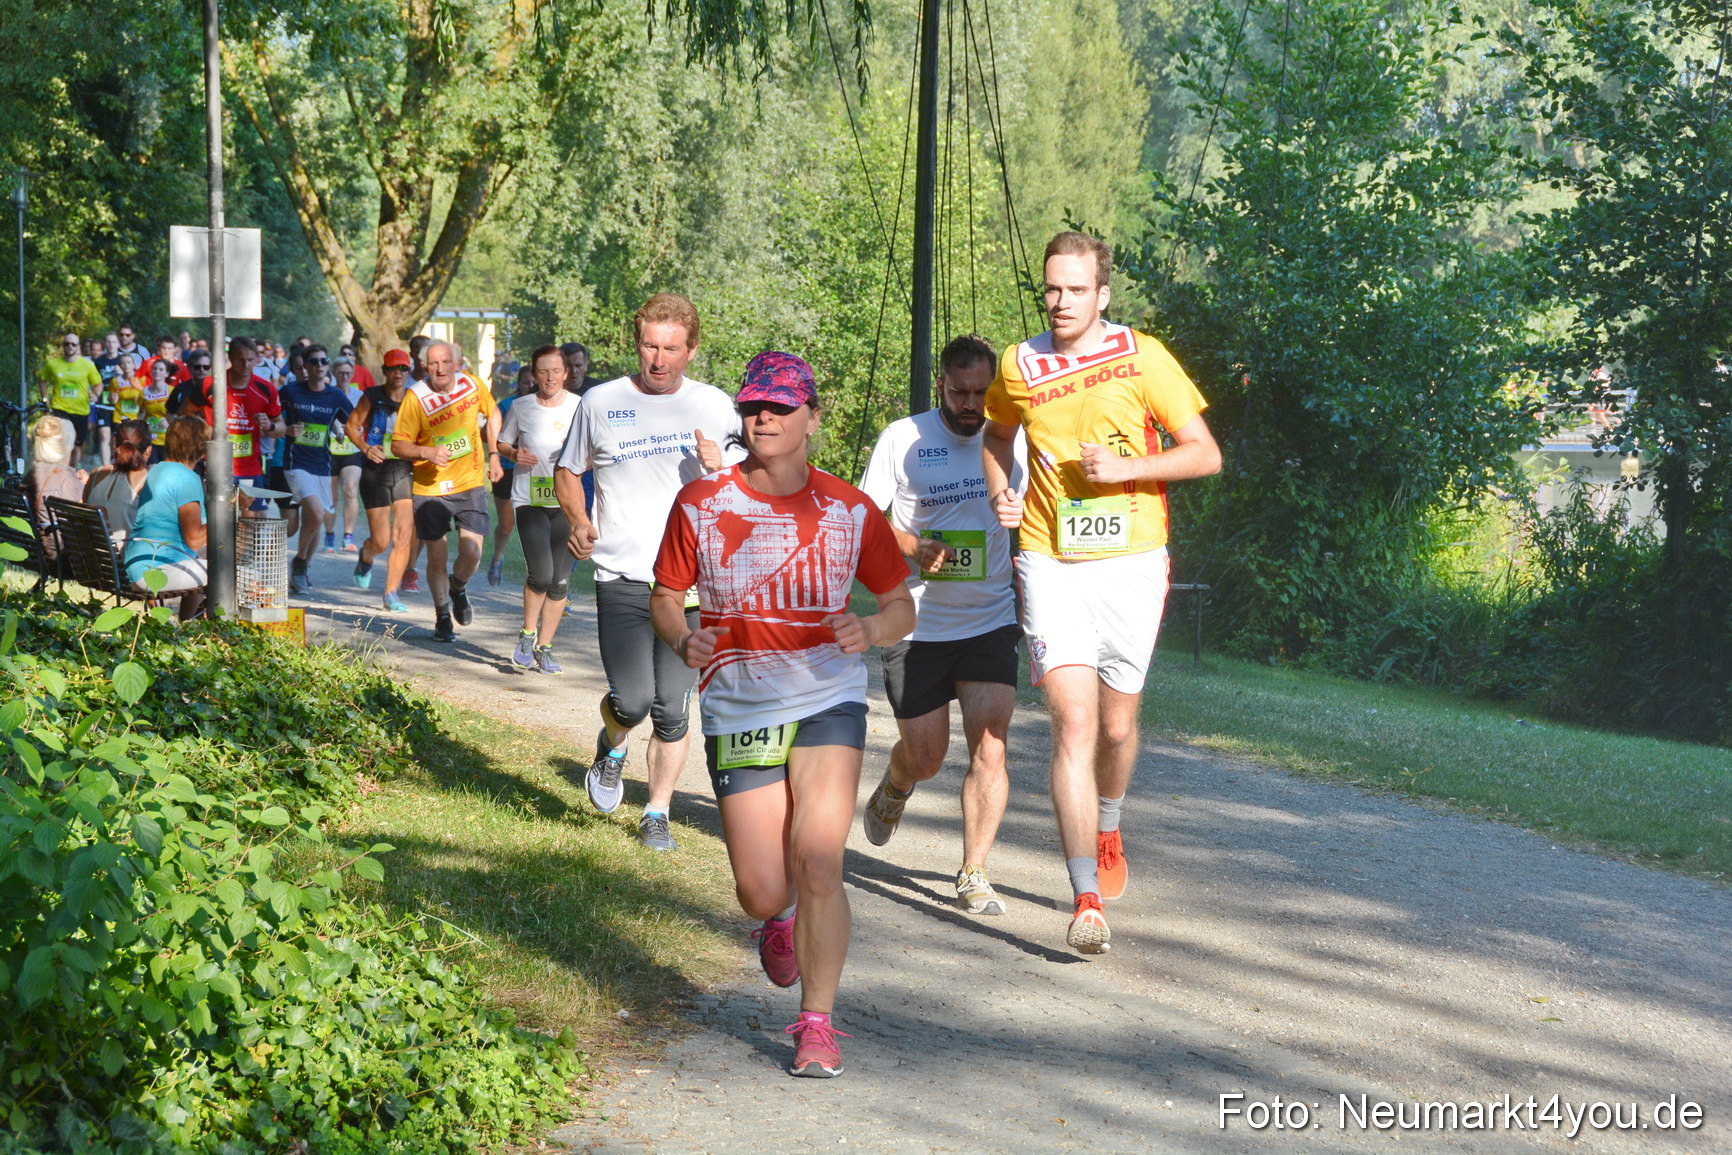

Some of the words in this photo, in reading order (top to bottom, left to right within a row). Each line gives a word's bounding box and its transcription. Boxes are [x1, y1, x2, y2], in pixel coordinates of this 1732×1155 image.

[1029, 381, 1077, 410] MAX
[1084, 363, 1141, 390] BÖGL
[429, 411, 454, 428] MAX
[607, 410, 636, 419] DESS
[302, 431, 321, 441] 490
[619, 437, 647, 450] Unser
[650, 432, 678, 444] Sport
[680, 431, 692, 441] ist
[446, 438, 467, 452] 289
[612, 443, 697, 464] Schüttguttranspo
[918, 447, 948, 458] DESS
[929, 482, 960, 495] Unser
[963, 477, 986, 488] Spor
[1066, 516, 1121, 536] 1205
[731, 724, 784, 748] 1841
[731, 748, 755, 756] Federsel
